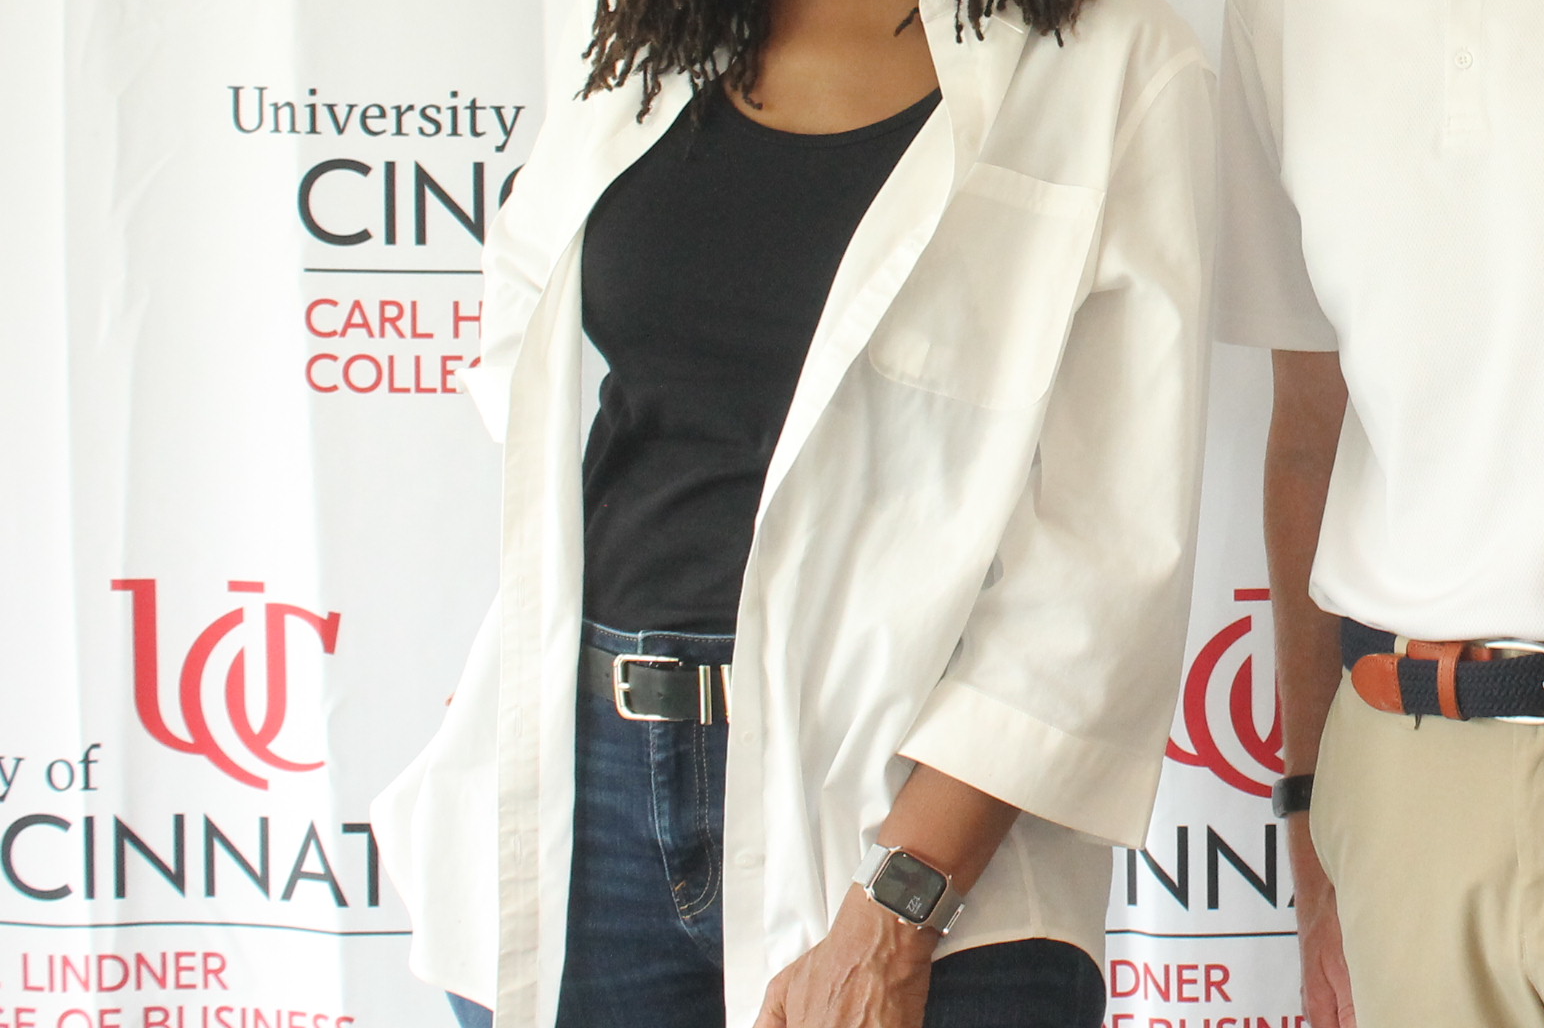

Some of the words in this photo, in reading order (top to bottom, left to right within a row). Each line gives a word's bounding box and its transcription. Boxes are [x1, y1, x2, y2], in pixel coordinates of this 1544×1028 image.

[228, 86, 526, 153] University
[305, 297, 435, 339] CARL
[305, 352, 482, 394] COLLE
[46, 743, 101, 792] of
[22, 950, 230, 992] LINDNER
